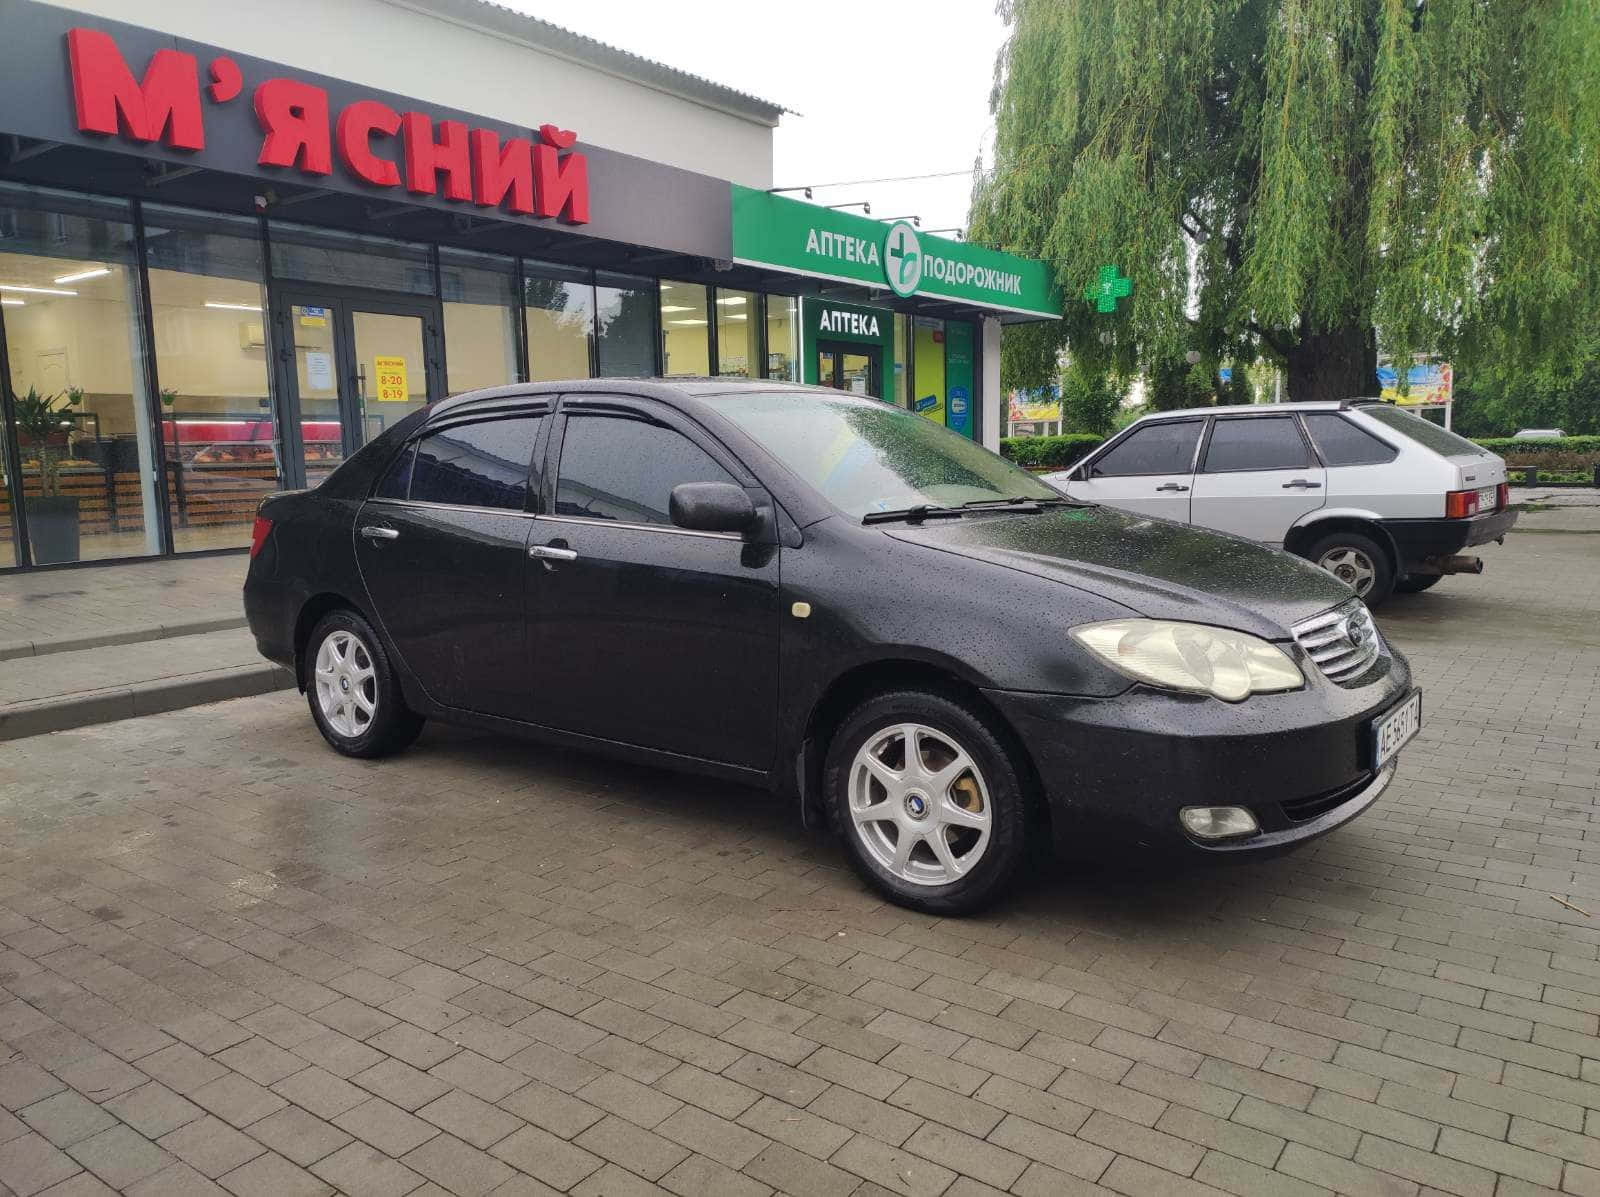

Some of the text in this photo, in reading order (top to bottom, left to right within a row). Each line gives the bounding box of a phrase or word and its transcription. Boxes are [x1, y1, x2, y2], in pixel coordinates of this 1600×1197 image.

[67, 27, 589, 225] М'ЯСНИЙ
[806, 229, 1022, 295] АПТЕКА ПОДОРОЖНИК
[820, 310, 880, 336] АПТЕКА
[381, 376, 402, 385] 8-20
[383, 389, 403, 399] 8-19
